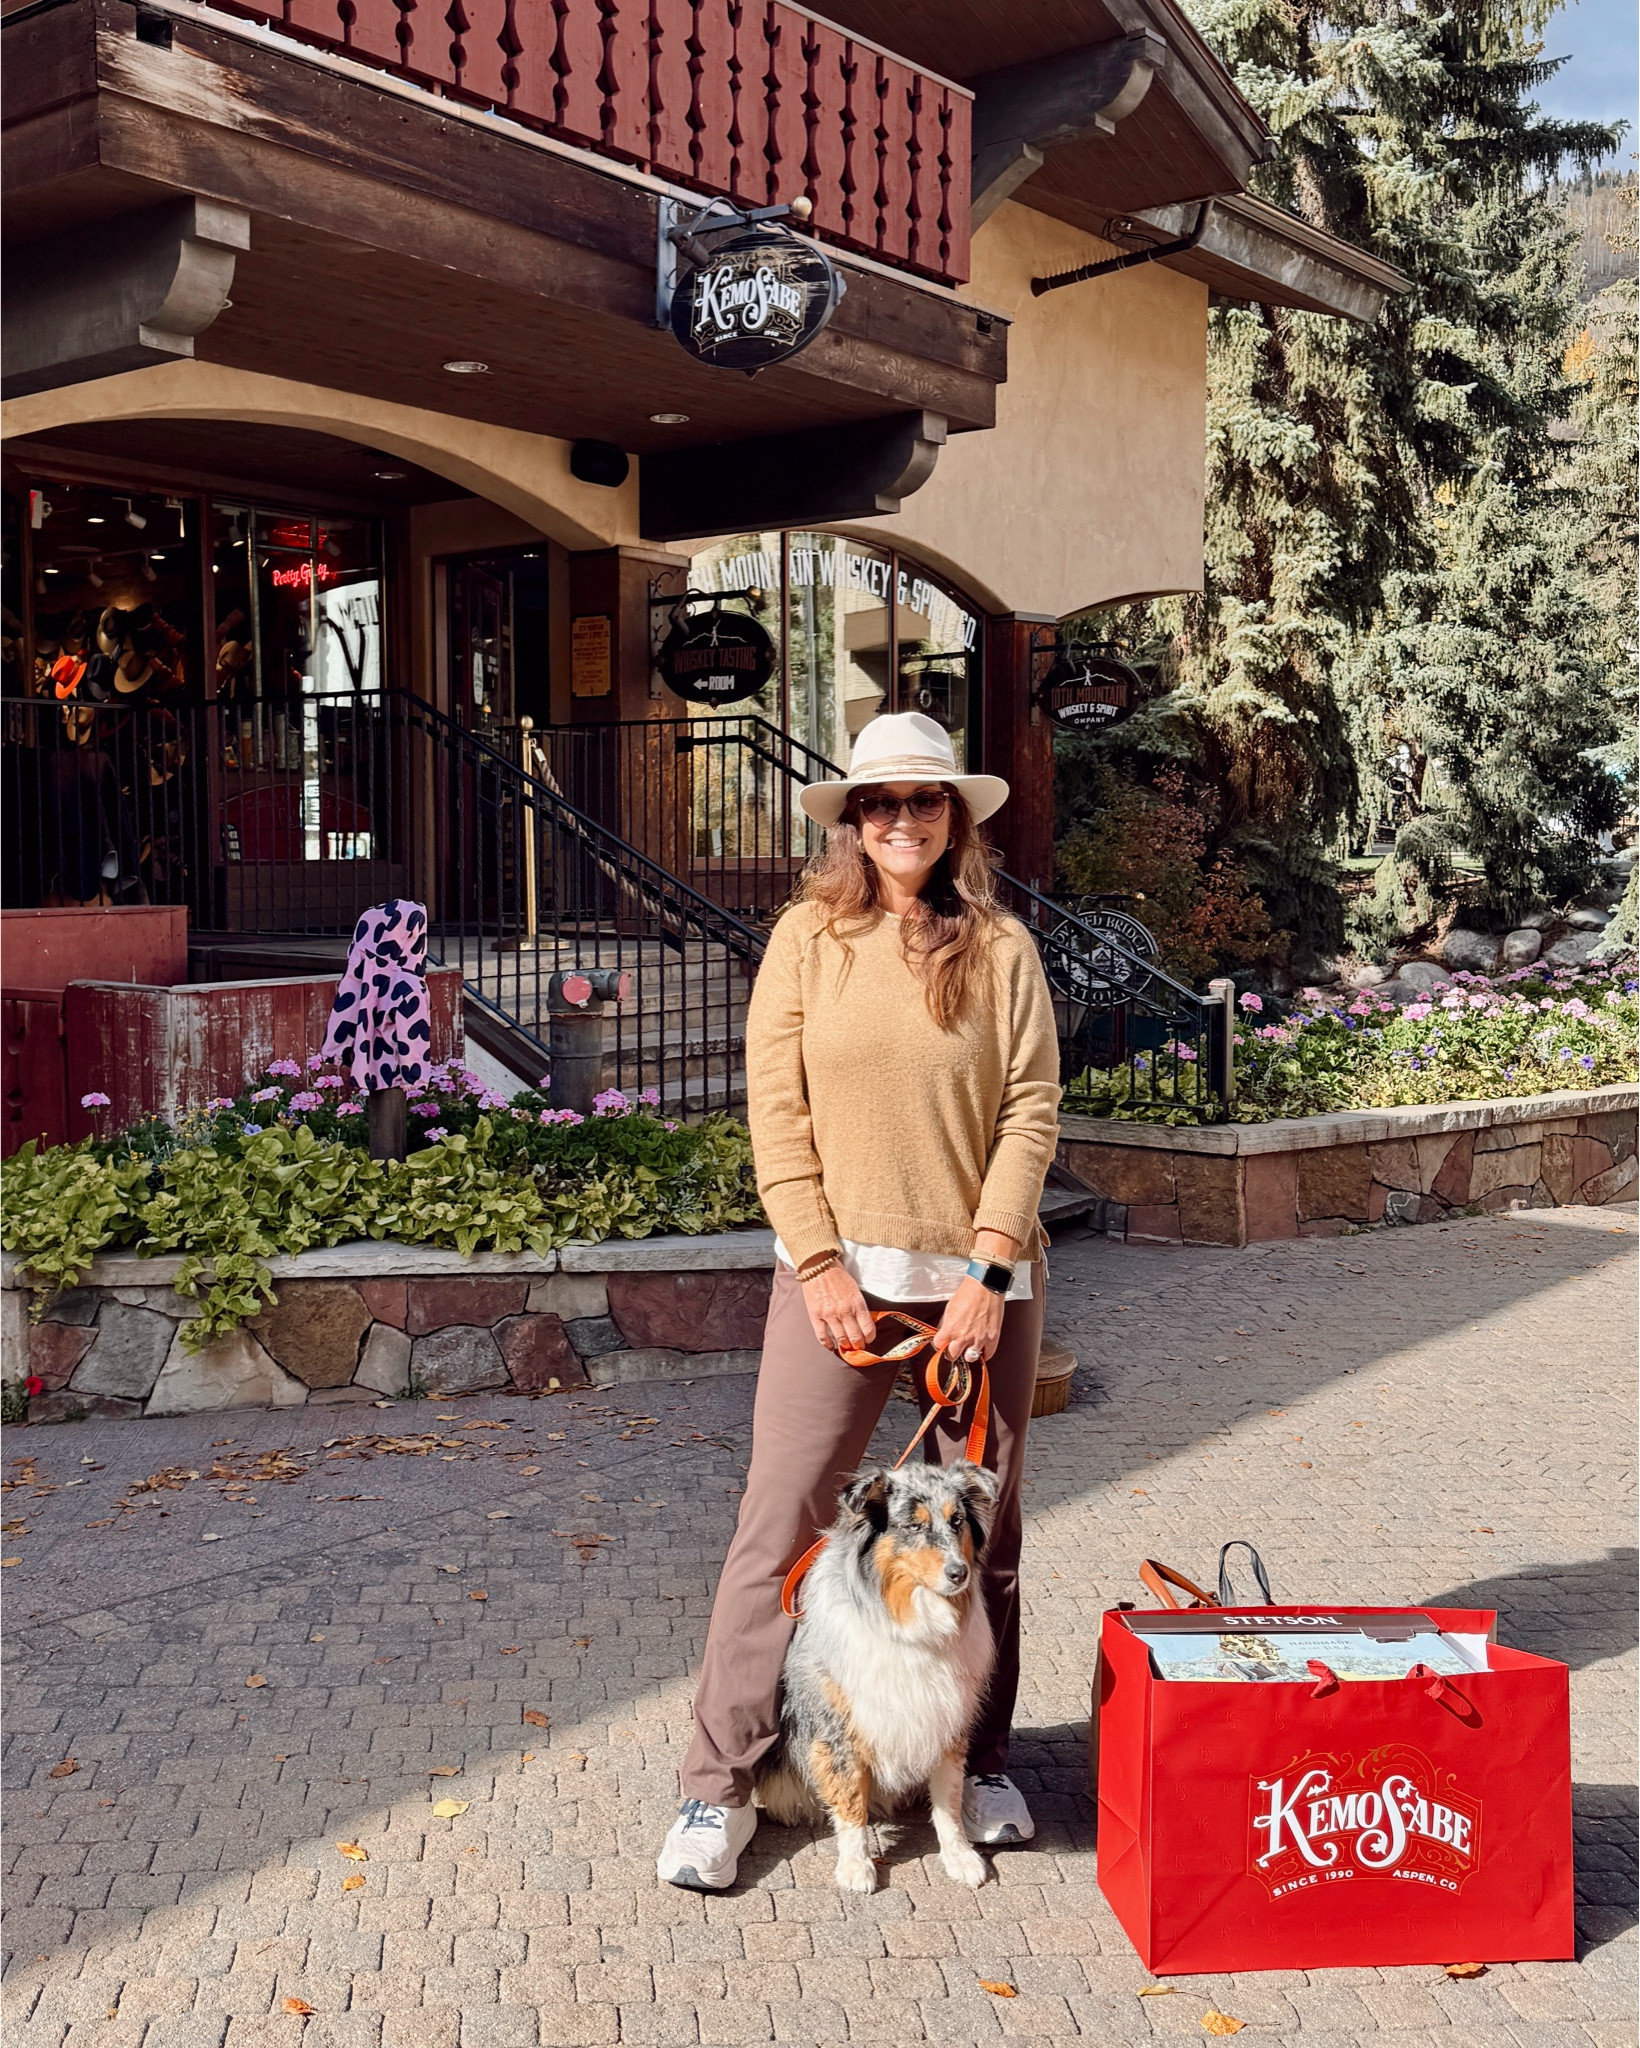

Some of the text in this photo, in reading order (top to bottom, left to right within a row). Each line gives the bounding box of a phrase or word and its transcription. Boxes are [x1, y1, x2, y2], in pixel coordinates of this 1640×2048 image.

[715, 331, 738, 342] SINCE
[272, 569, 300, 588] Pretty
[719, 549, 815, 592] MOUNTAIN
[819, 551, 892, 598] WHISKEY
[897, 570, 907, 606] &
[674, 646, 757, 675] WHISKEY TASTING
[708, 675, 735, 691] ROOM
[1051, 683, 1128, 710] 10TH MOUNTAIN
[1058, 702, 1119, 719] WHISKEY & SPIRIT
[1106, 916, 1151, 957] BRIDGE
[1273, 1869, 1458, 1897] SINCE 1990 ASPEN, CO
